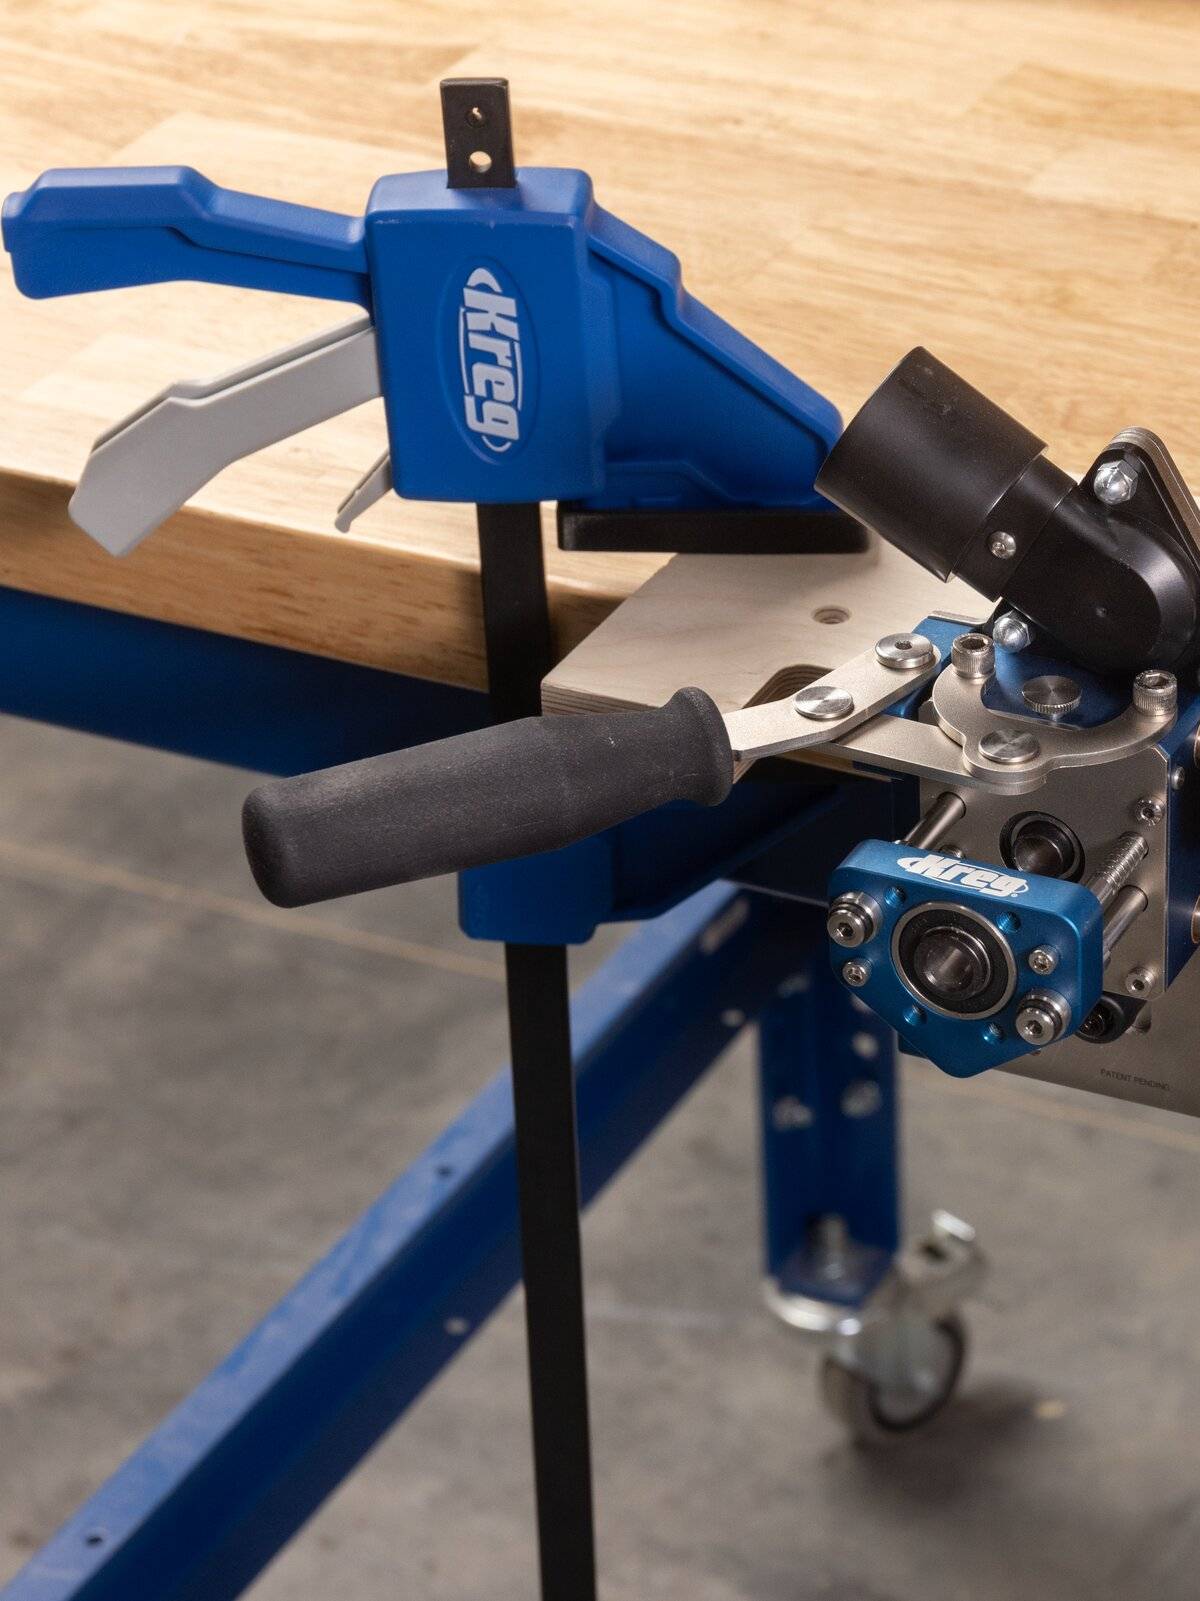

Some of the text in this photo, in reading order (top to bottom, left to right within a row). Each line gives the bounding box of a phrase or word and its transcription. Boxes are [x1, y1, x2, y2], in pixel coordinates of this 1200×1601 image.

[463, 287, 519, 440] Kreg
[904, 854, 1027, 898] Kreg
[1100, 1068, 1132, 1082] PATENT
